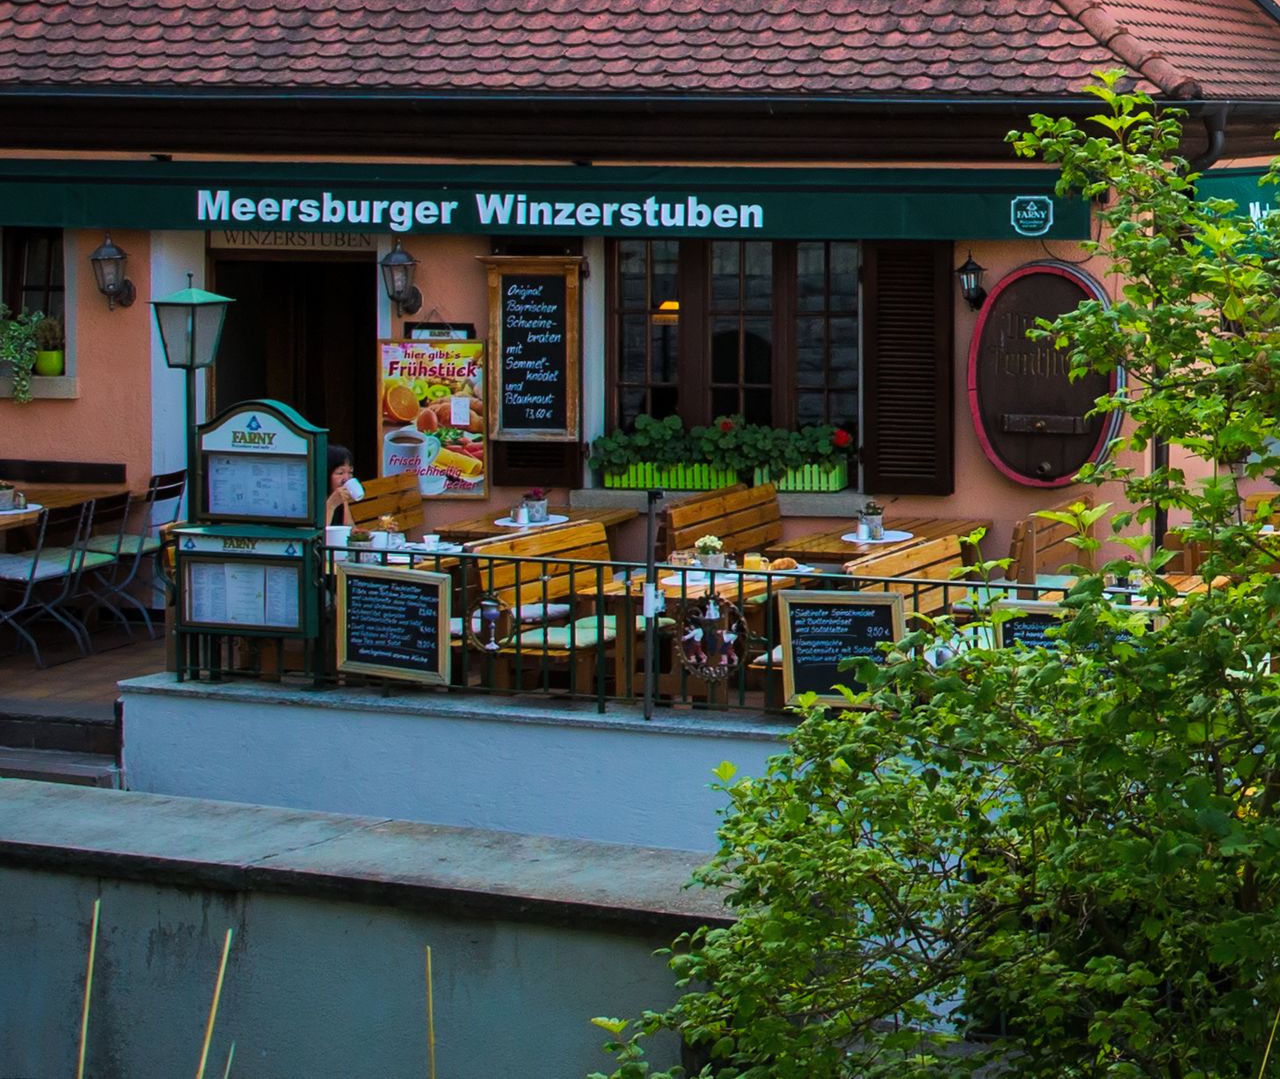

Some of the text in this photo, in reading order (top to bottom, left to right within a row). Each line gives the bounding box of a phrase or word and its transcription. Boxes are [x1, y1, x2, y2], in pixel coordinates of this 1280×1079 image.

[197, 190, 764, 232] Meersburger Winzerstuben
[1017, 210, 1047, 219] FARNY
[222, 229, 372, 248] WINZERSTUBEN
[507, 284, 544, 300] Original
[506, 300, 558, 313] Bayrischer
[527, 331, 561, 344] braten
[404, 350, 426, 359] hier
[506, 342, 523, 354] mit
[388, 361, 478, 378] Frühstück
[526, 370, 559, 382] knödel
[505, 382, 524, 391] und
[504, 391, 555, 405] Blaukraut
[231, 431, 277, 445] FARNY
[388, 454, 422, 466] frisch
[442, 479, 479, 490] lecker
[223, 537, 257, 550] FARNY
